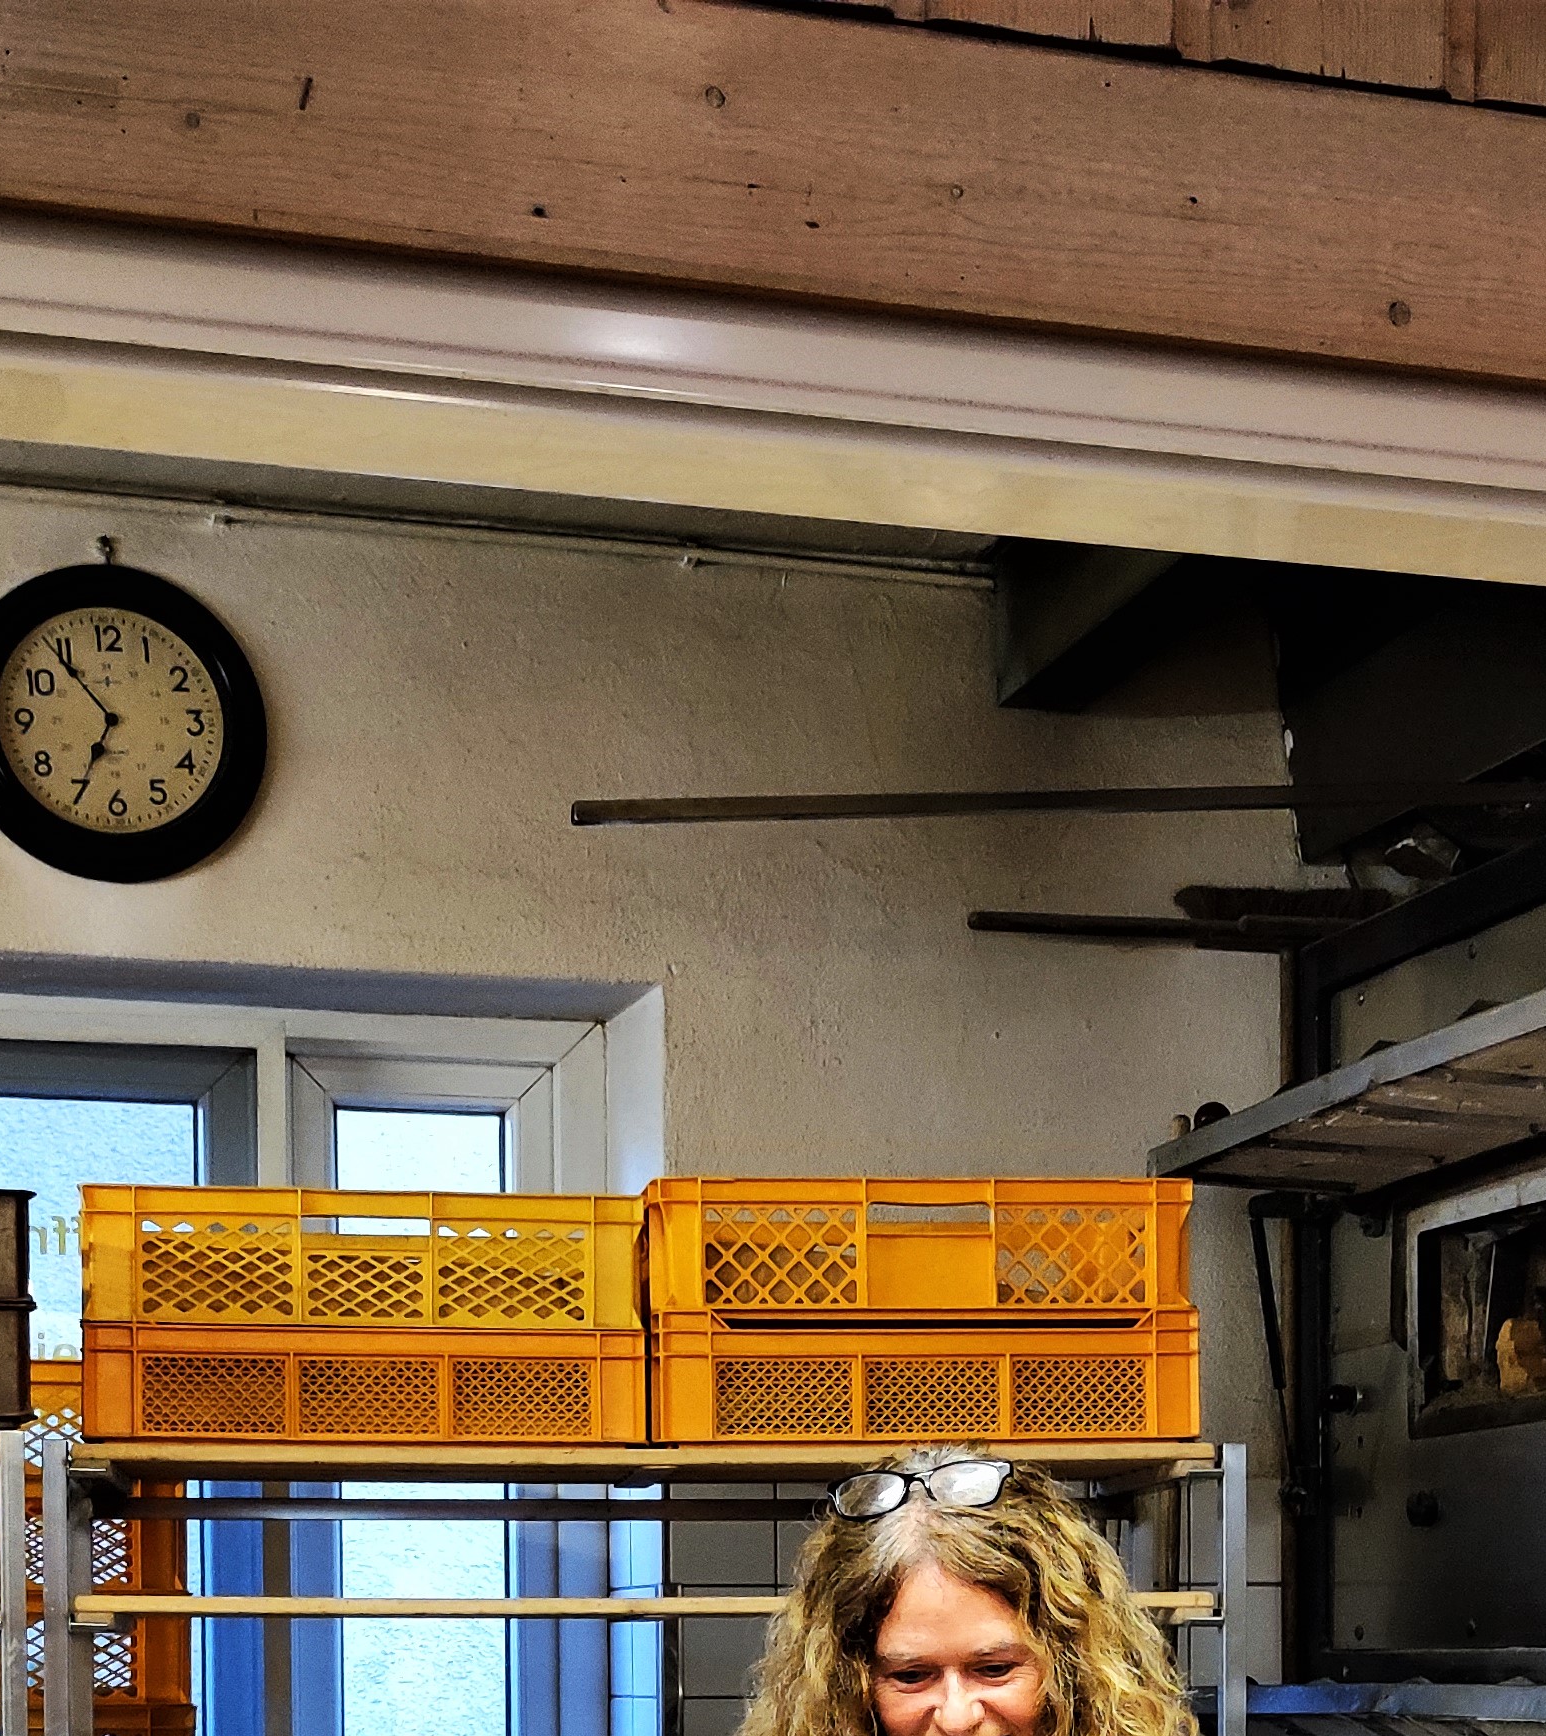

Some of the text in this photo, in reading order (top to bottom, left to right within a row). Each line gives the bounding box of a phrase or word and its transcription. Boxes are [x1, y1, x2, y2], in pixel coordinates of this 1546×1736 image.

[95, 625, 123, 652] 12
[142, 637, 150, 664] 1
[27, 669, 54, 695] 10
[169, 667, 189, 692] 2
[15, 709, 34, 734] 9
[186, 709, 205, 735] 3
[35, 751, 52, 776] 8
[175, 749, 196, 775] 4
[72, 780, 89, 804] 7
[109, 789, 127, 816] 6
[149, 779, 166, 804] 5
